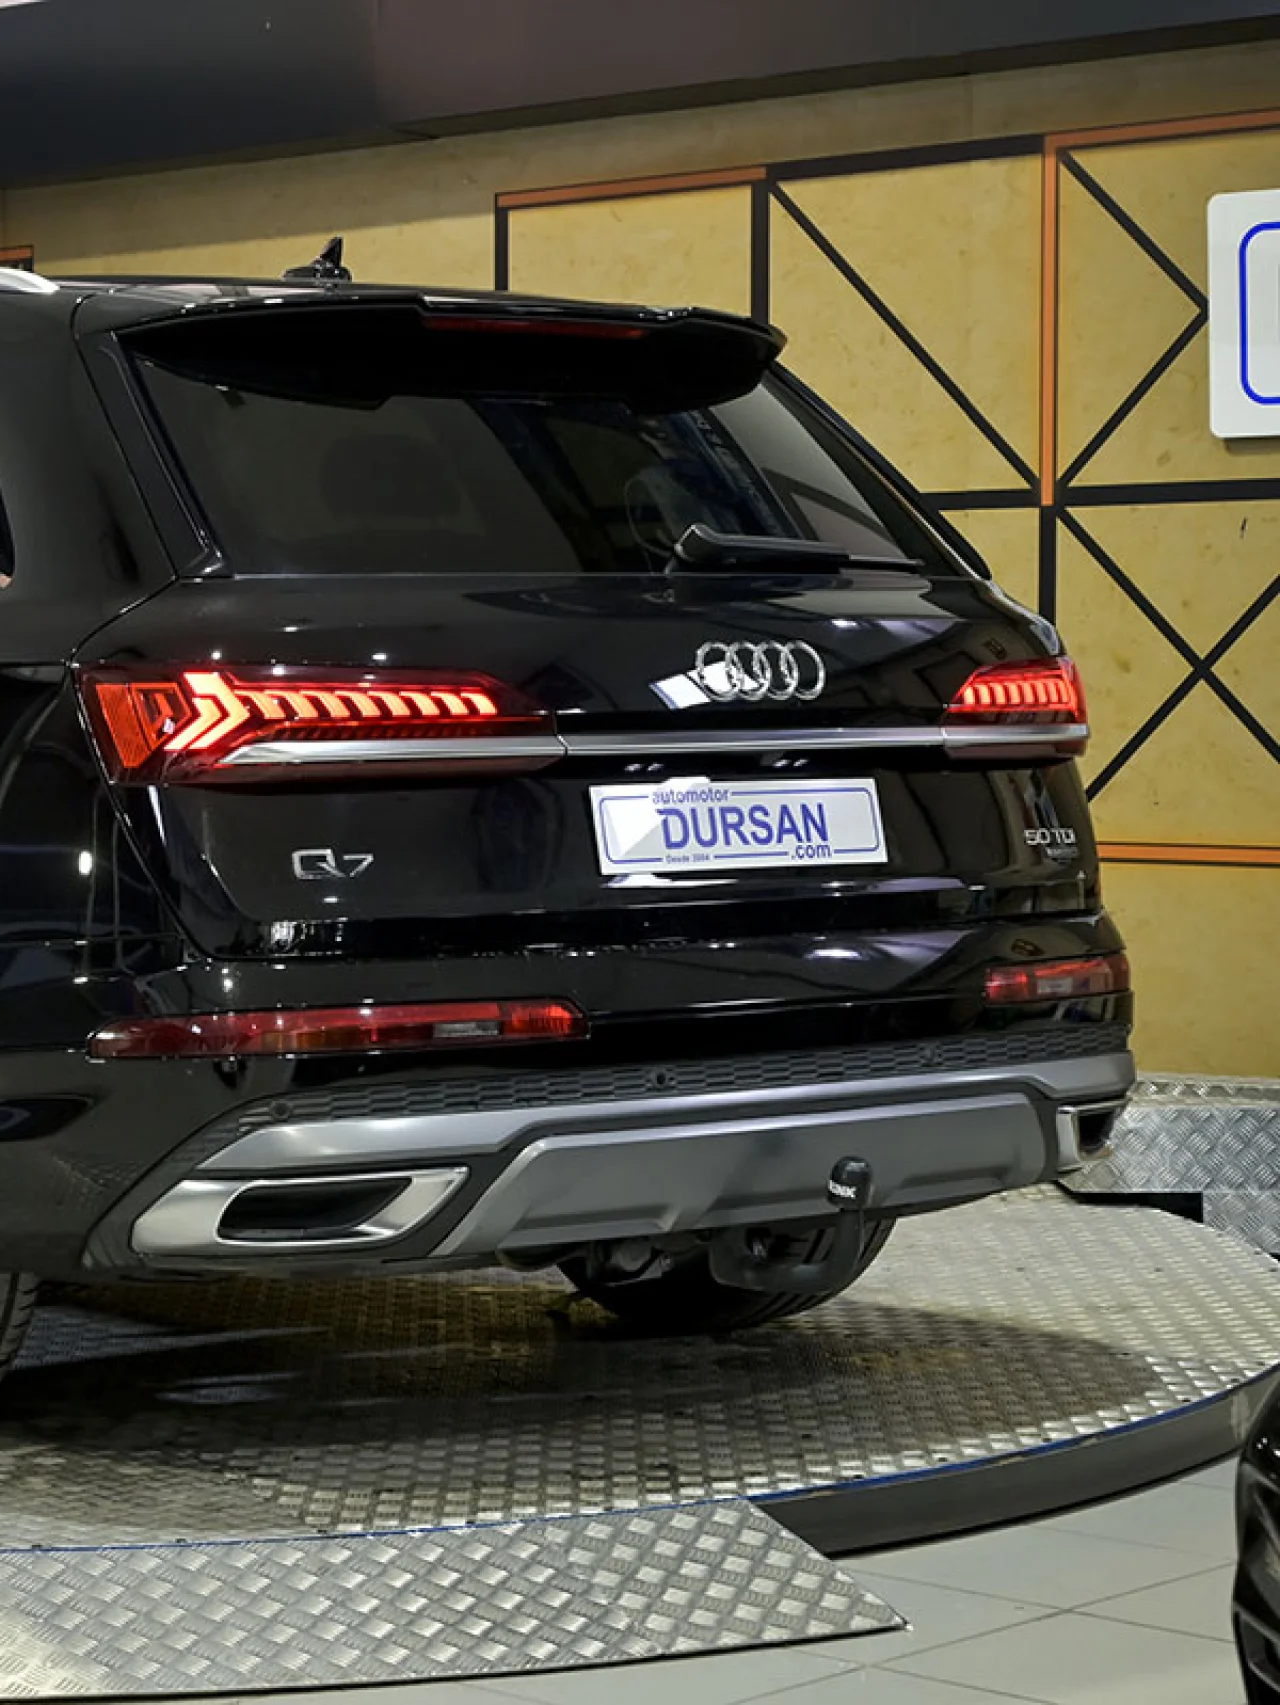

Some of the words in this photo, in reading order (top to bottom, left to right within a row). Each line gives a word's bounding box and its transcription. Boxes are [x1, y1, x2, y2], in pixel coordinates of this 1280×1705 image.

[652, 787, 730, 805] automotor
[655, 802, 829, 850] DURSAN
[1023, 828, 1050, 846] 50
[791, 843, 832, 860] .com
[292, 848, 374, 880] Q7
